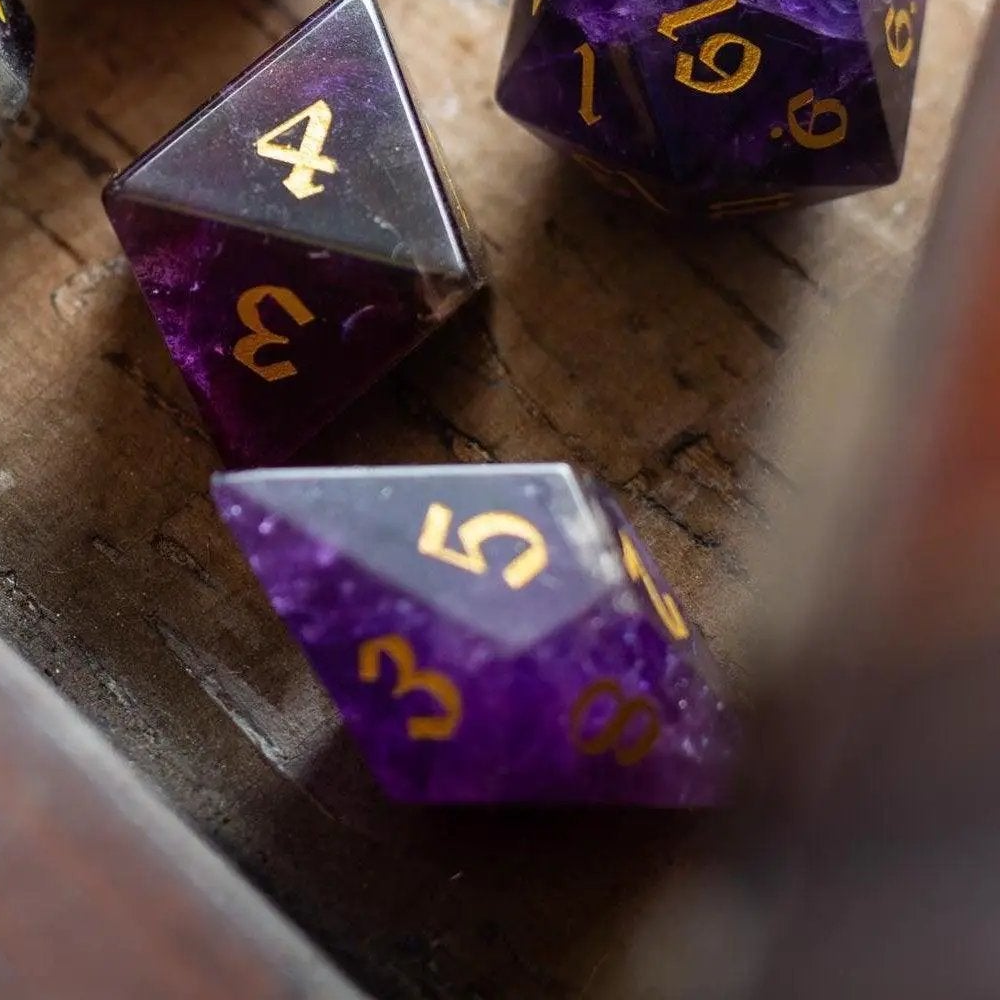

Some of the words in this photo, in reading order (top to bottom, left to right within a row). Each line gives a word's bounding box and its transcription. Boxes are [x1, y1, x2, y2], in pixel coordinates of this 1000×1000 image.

[573, 42, 602, 126] 1
[253, 100, 339, 200] 4
[233, 285, 314, 383] 3
[417, 503, 548, 590] 5
[359, 634, 463, 742] 3
